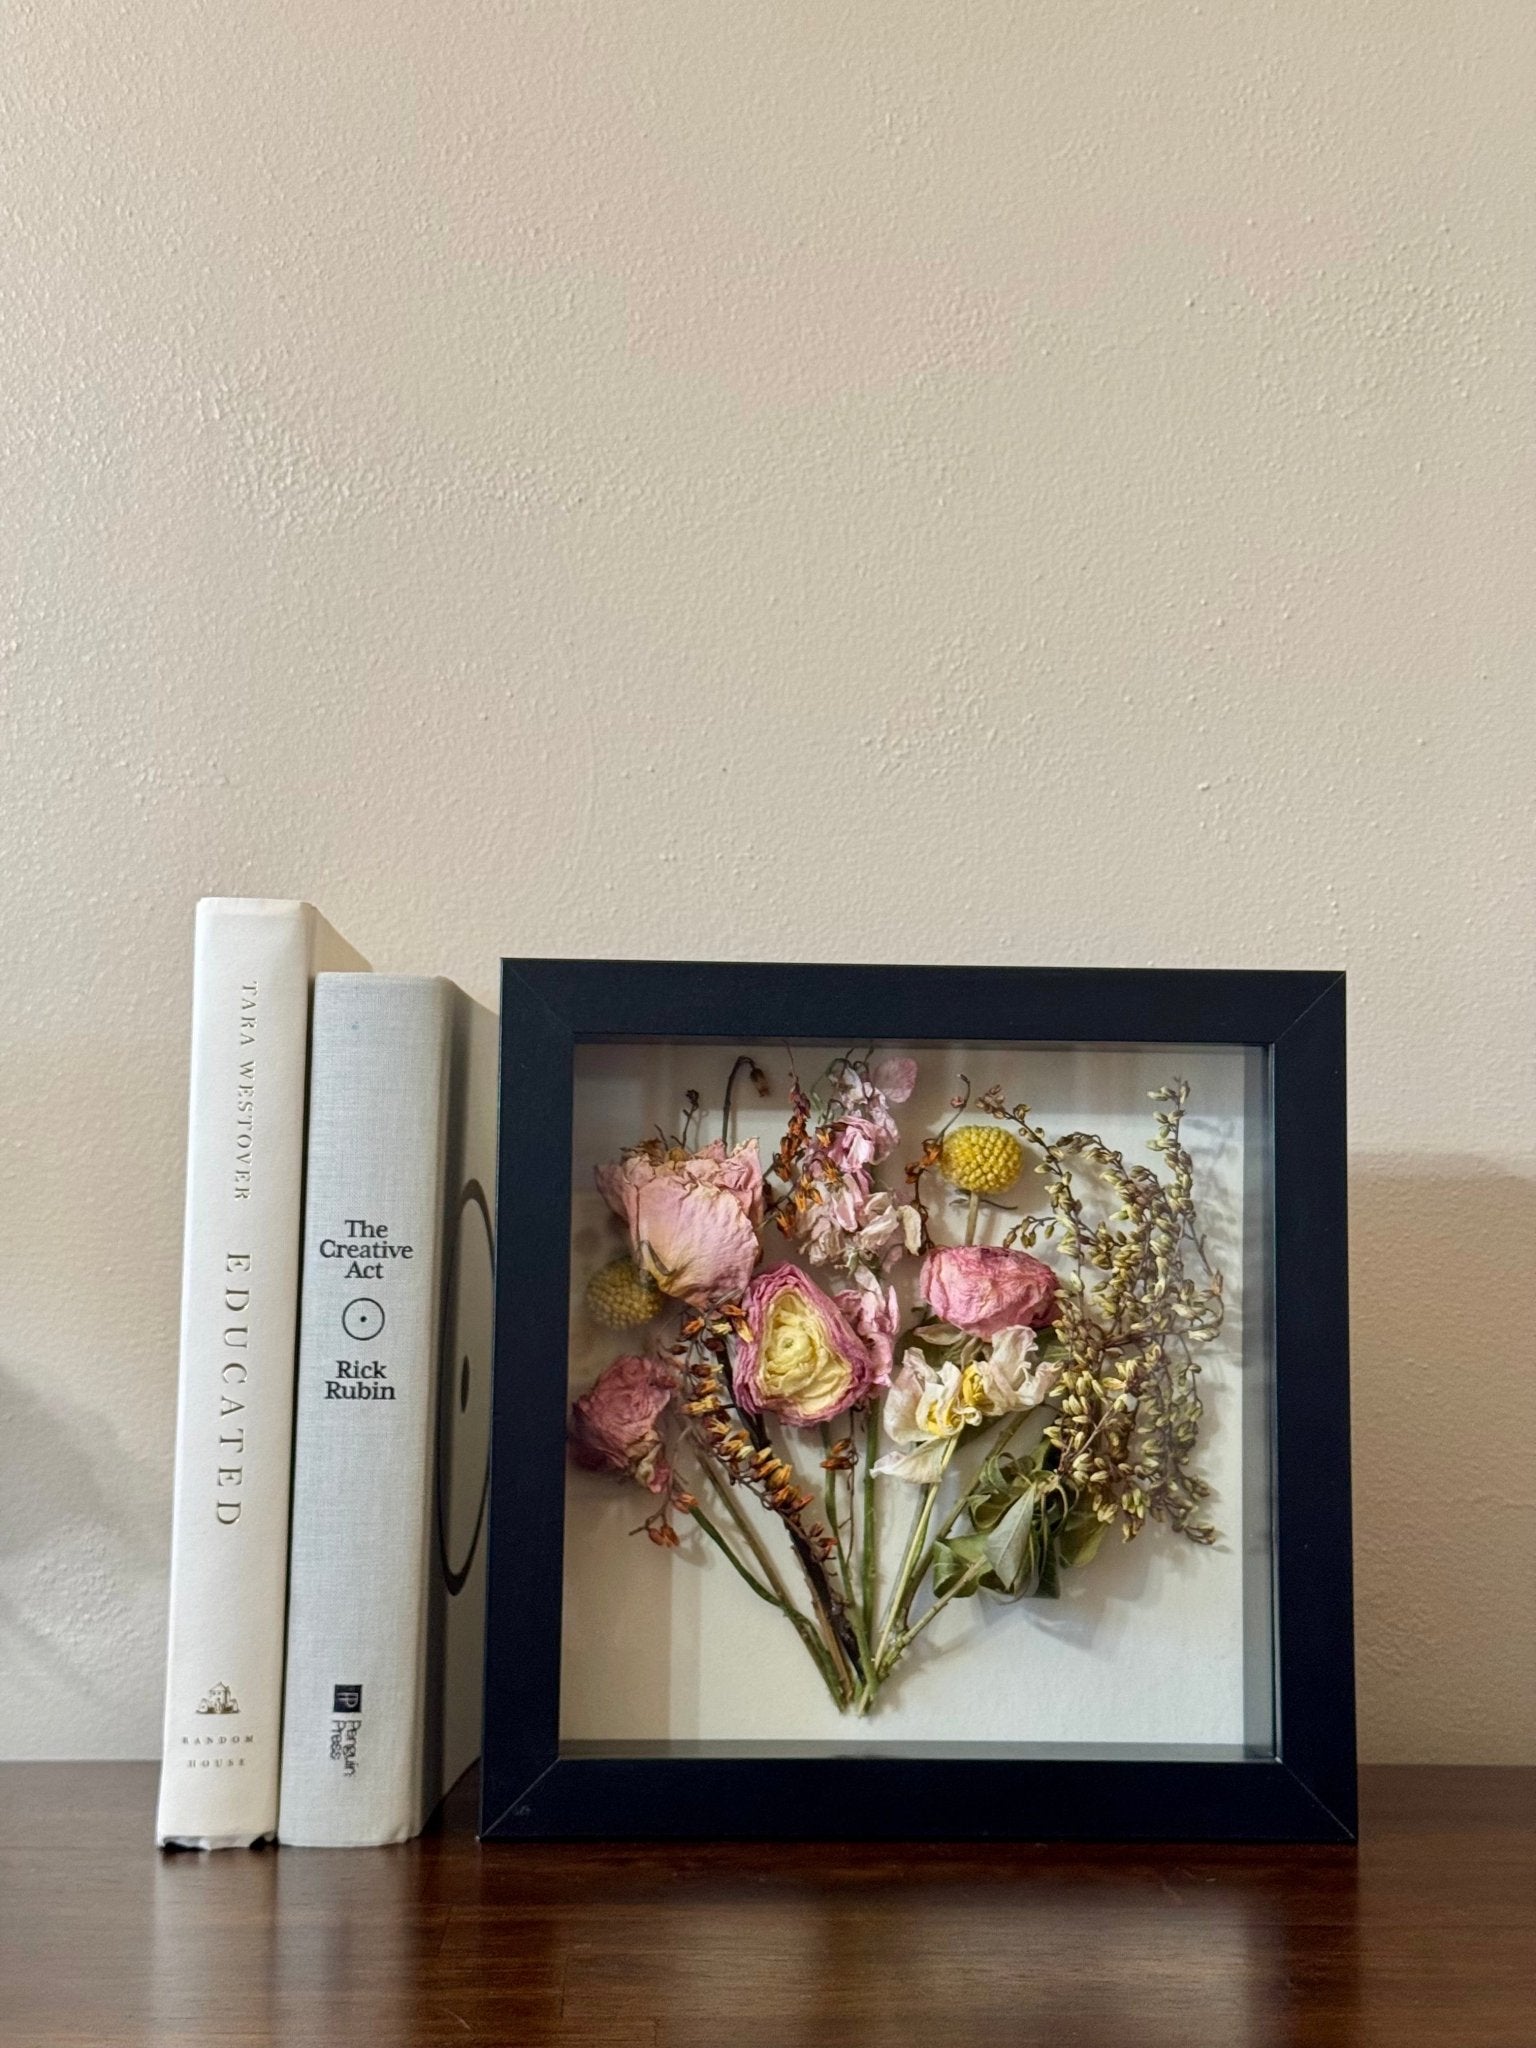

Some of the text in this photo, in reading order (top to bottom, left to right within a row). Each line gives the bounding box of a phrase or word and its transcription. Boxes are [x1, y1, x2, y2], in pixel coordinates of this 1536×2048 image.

[234, 981, 258, 1200] TARA WESTOVER
[344, 1219, 389, 1238] The
[319, 1238, 414, 1259] Creative
[344, 1260, 385, 1279] Act
[336, 1360, 388, 1379] Rick
[217, 1253, 251, 1525] EDUCATED
[325, 1380, 397, 1400] Rubin
[181, 1734, 255, 1745] RANDOM
[329, 1719, 346, 1761] Press
[342, 1719, 361, 1777] Penguin
[187, 1757, 247, 1768] HOUSE
